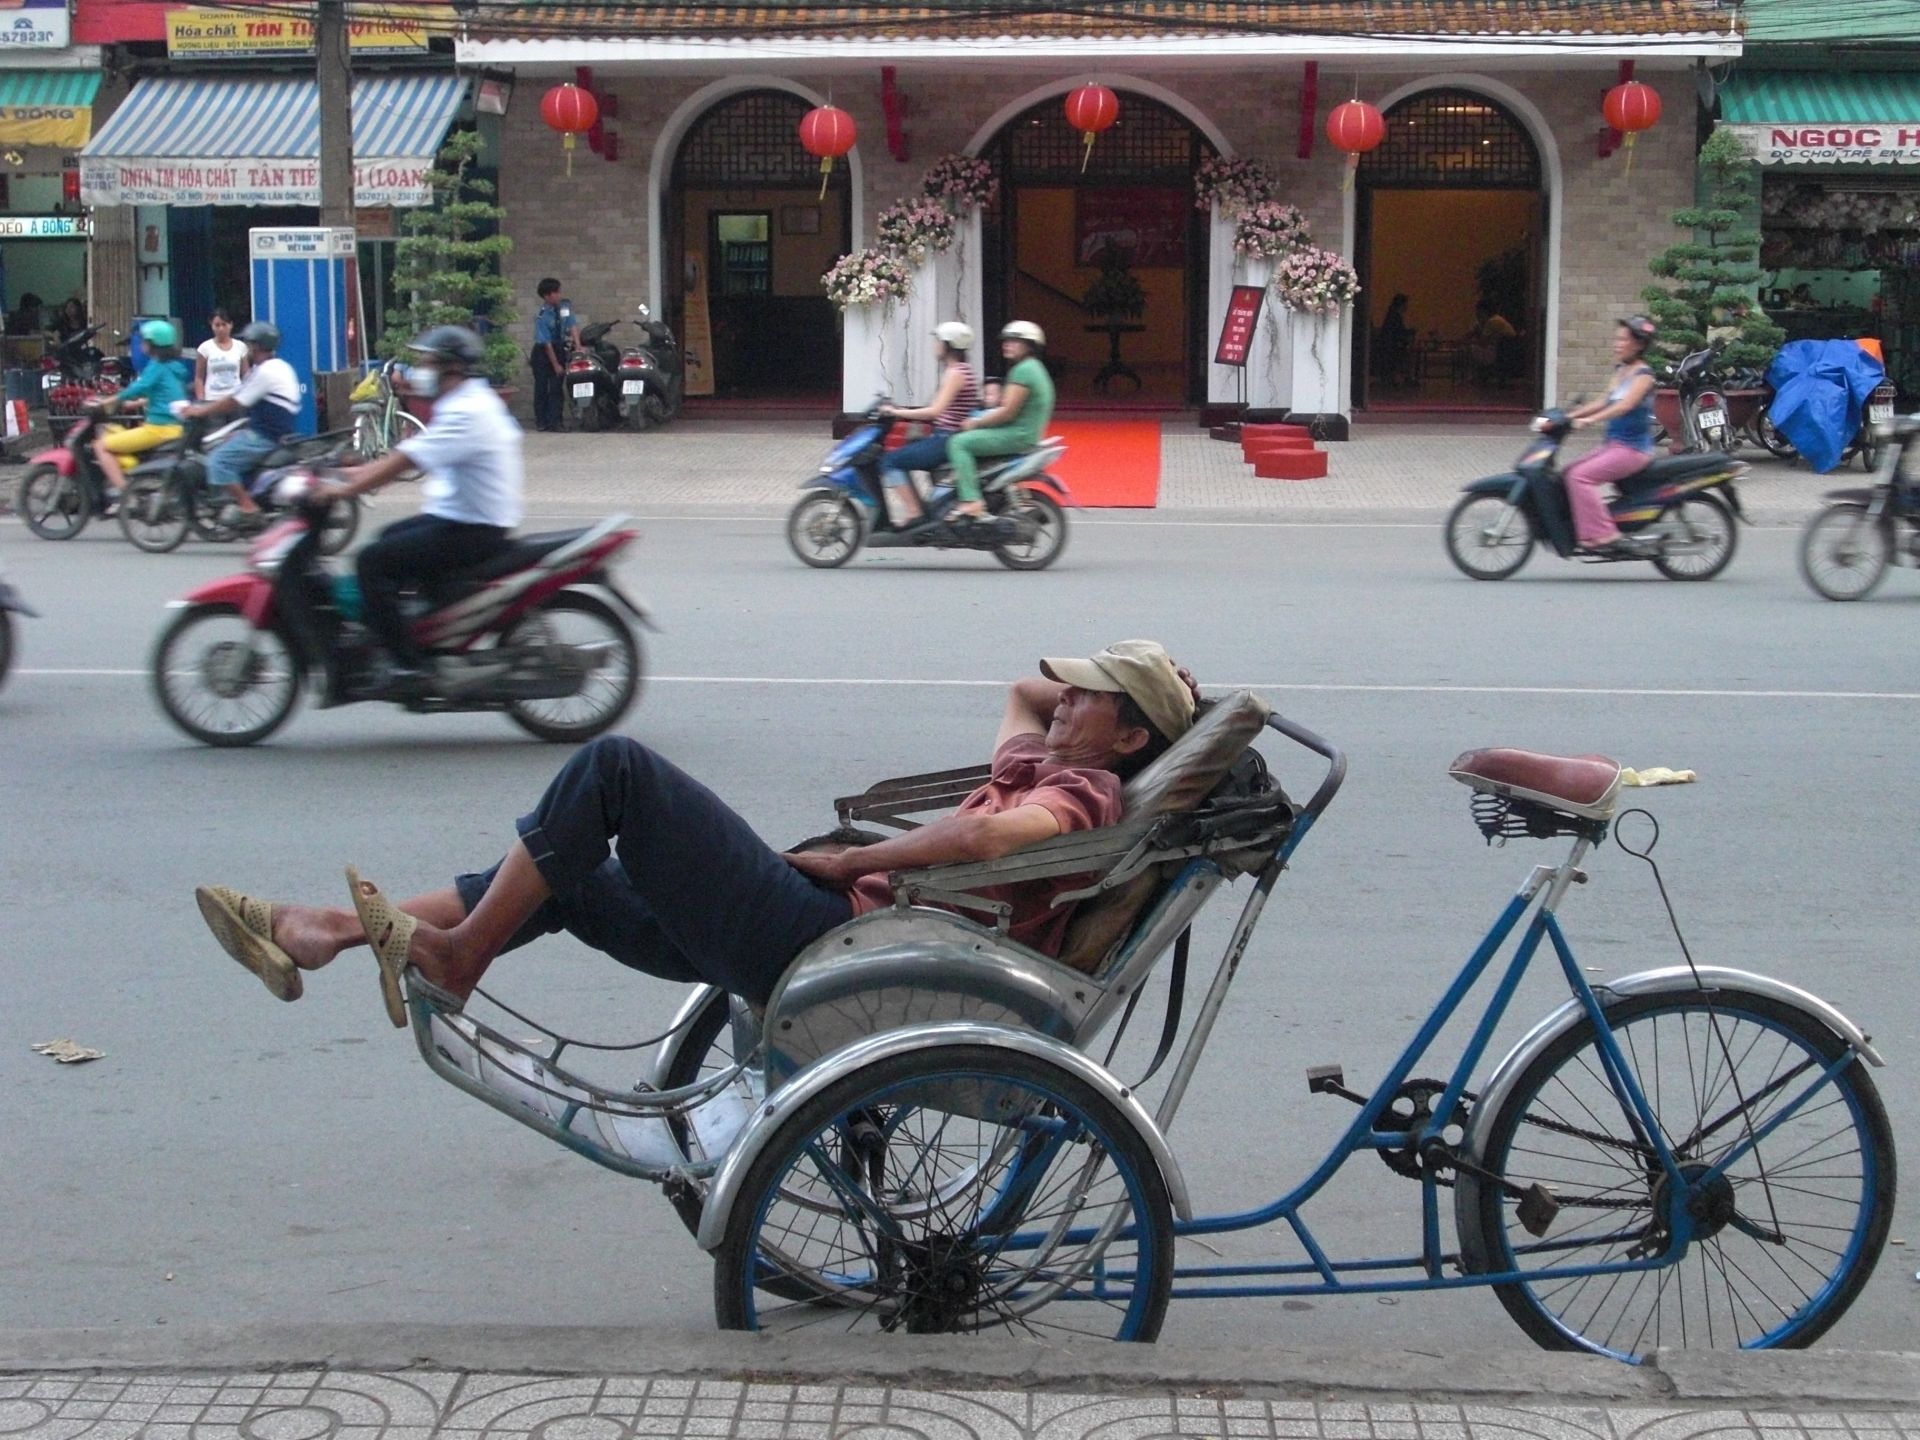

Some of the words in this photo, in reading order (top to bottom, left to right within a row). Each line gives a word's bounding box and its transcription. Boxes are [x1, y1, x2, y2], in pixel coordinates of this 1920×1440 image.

[175, 24, 201, 37] Hóa
[206, 22, 237, 37] chất
[245, 19, 282, 36] TÂN
[1771, 129, 1882, 150] NGỌC
[1879, 149, 1904, 158] EM
[156, 167, 174, 188] TM
[178, 163, 203, 189] HÓA
[206, 161, 238, 188] CHẤT
[248, 162, 285, 187] TÂN
[289, 159, 320, 187] TIẾ
